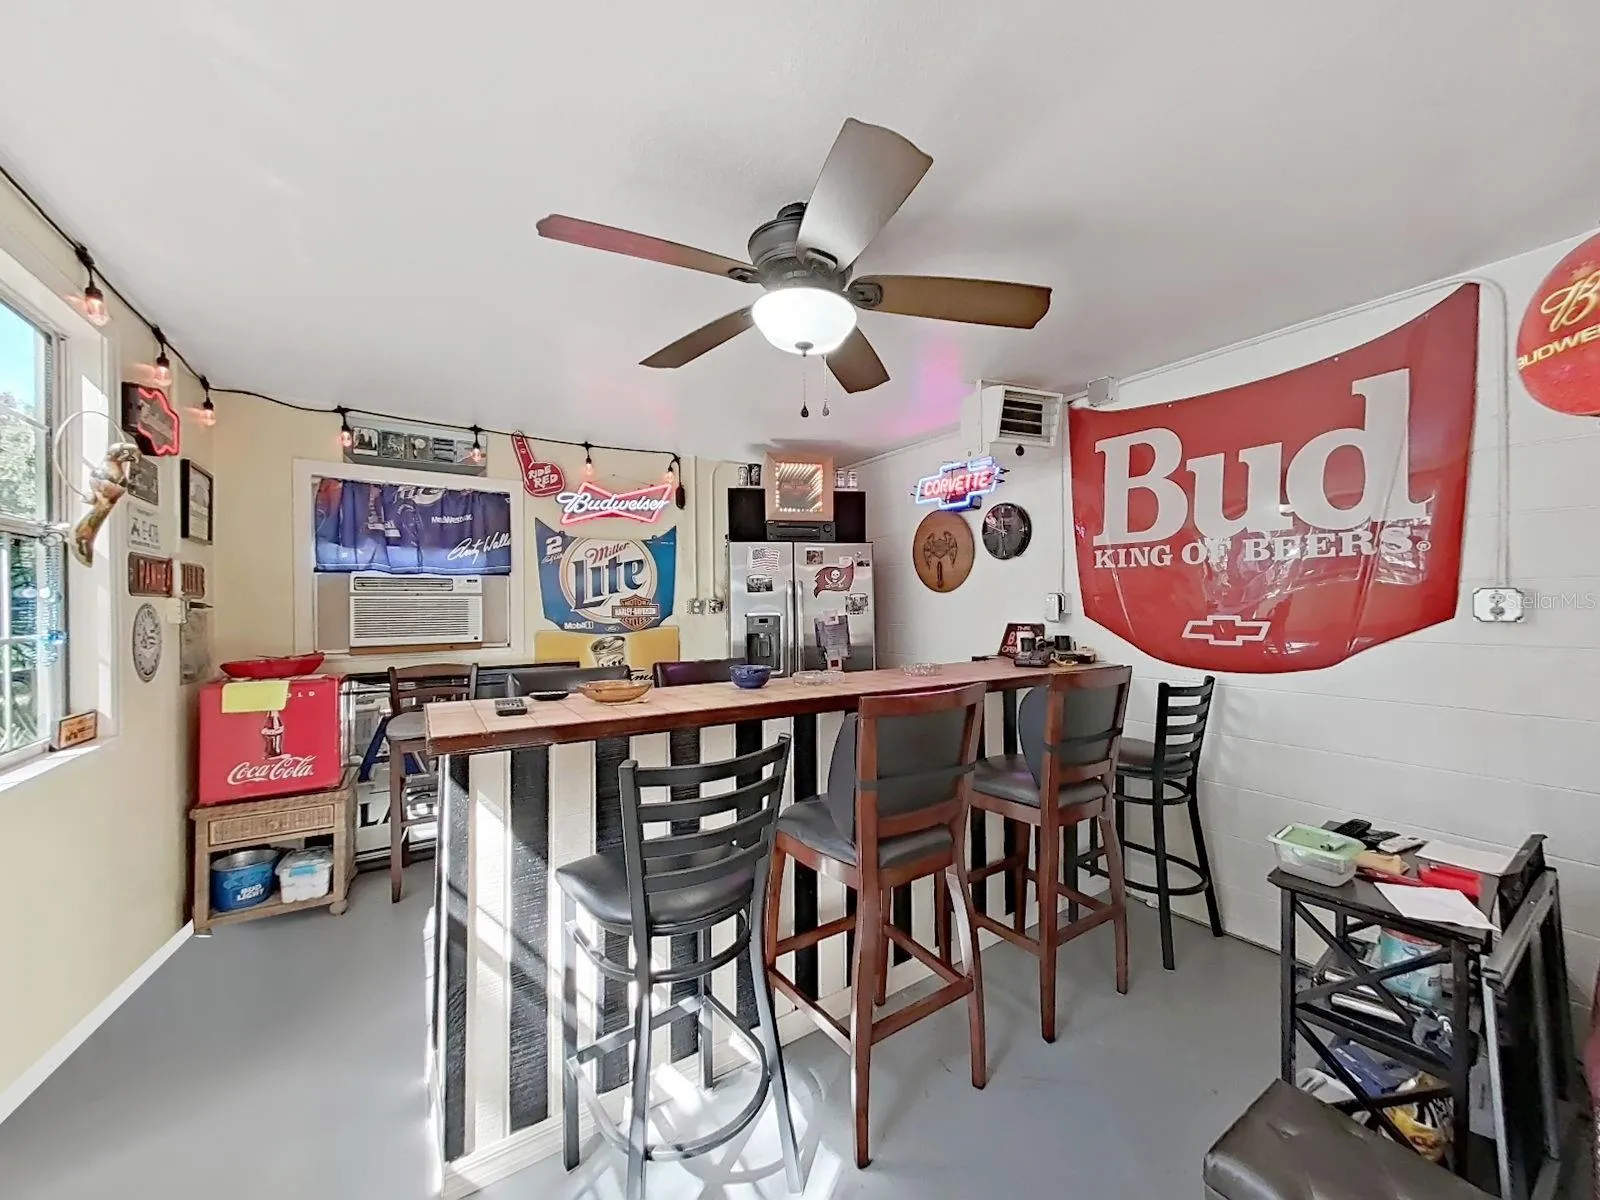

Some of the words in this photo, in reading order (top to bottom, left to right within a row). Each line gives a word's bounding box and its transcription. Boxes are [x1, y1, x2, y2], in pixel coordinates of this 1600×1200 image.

[1093, 368, 1435, 546] Bud
[527, 465, 551, 480] RIDE
[533, 473, 559, 488] RED
[923, 469, 992, 496] CORVETTE
[556, 491, 670, 513] Budweiser
[545, 535, 562, 556] 2
[585, 542, 630, 564] Miller
[1094, 545, 1173, 568] KING
[1182, 539, 1232, 565] OF
[1243, 528, 1413, 562] BEERS
[571, 555, 645, 609] Lite
[227, 753, 316, 785] Coca-Cola
